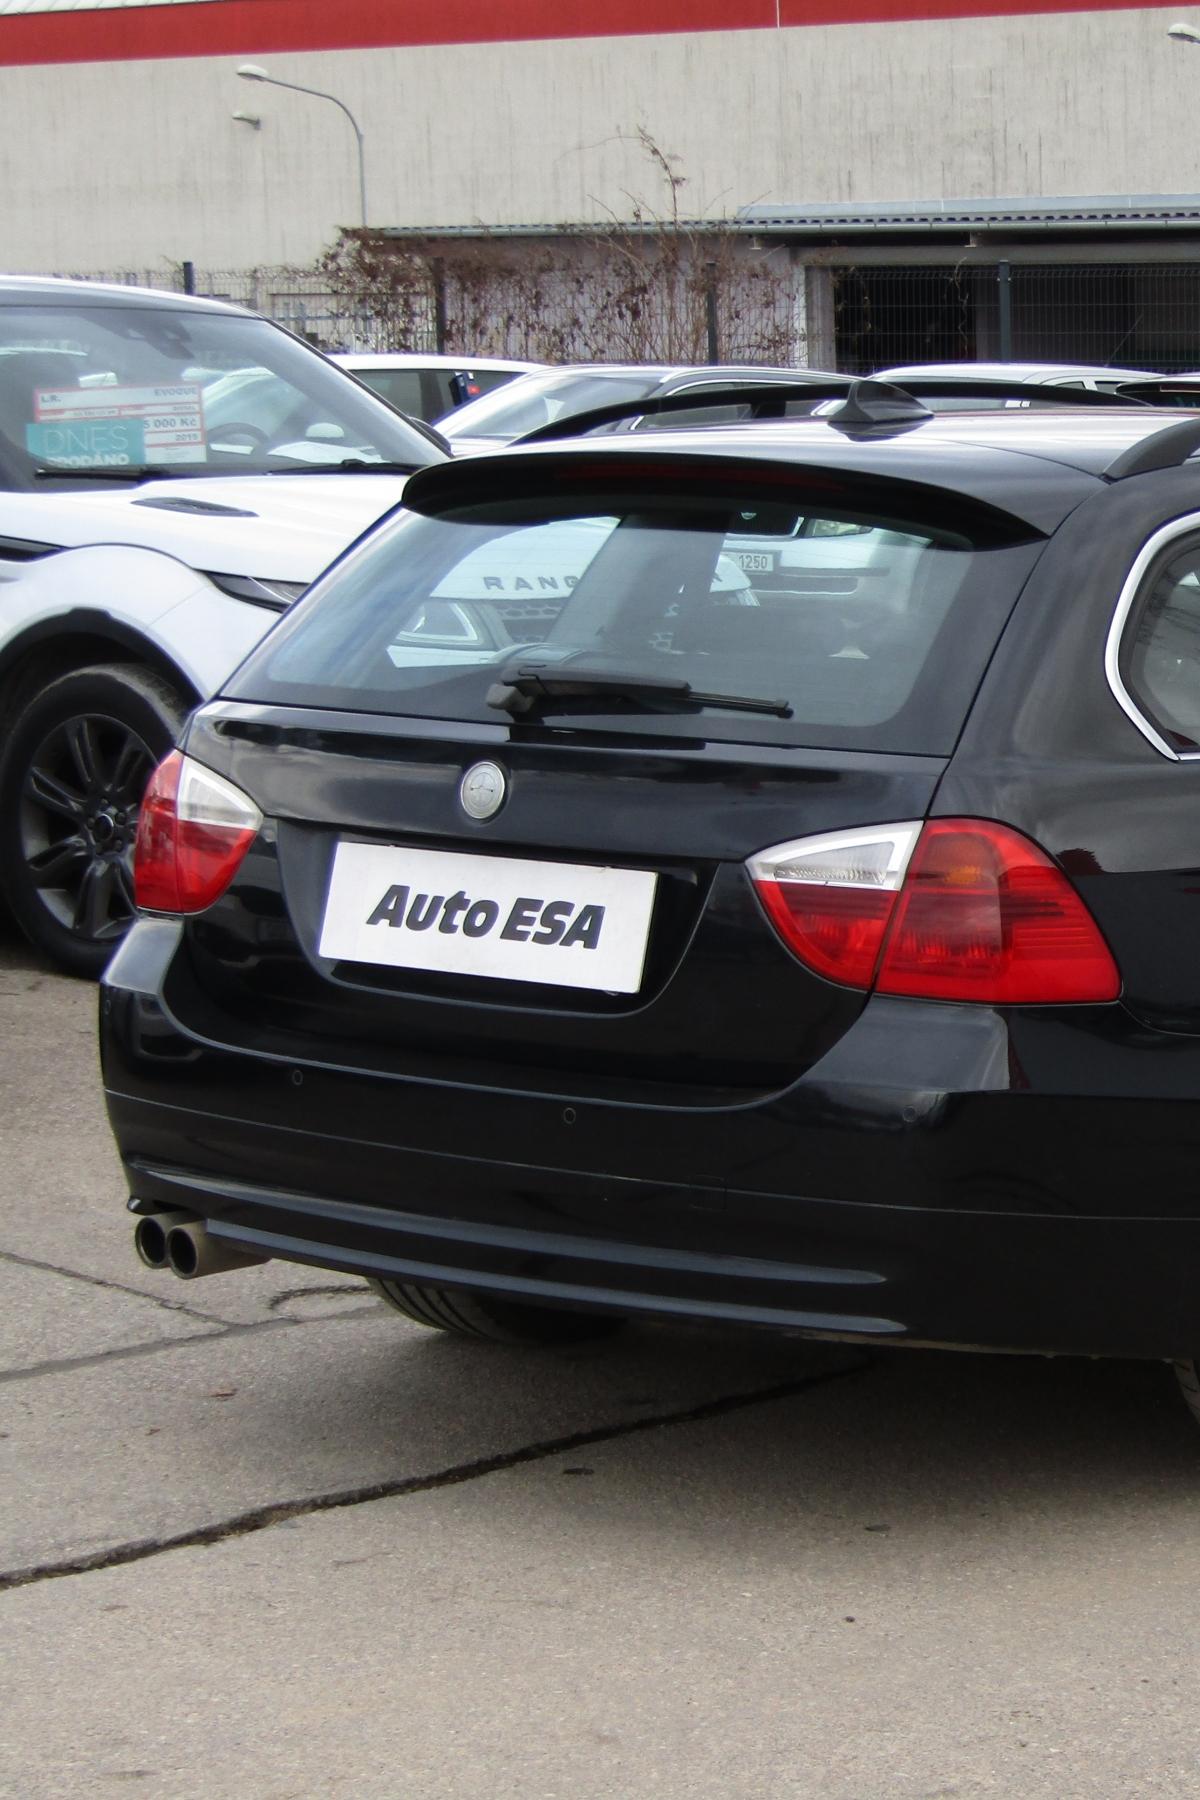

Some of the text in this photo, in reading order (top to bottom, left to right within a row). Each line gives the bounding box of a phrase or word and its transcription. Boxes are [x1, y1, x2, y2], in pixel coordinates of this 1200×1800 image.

[154, 418, 177, 429] 000
[44, 425, 129, 453] DNES
[738, 554, 769, 569] 1250
[366, 884, 606, 949] Auto ESA
